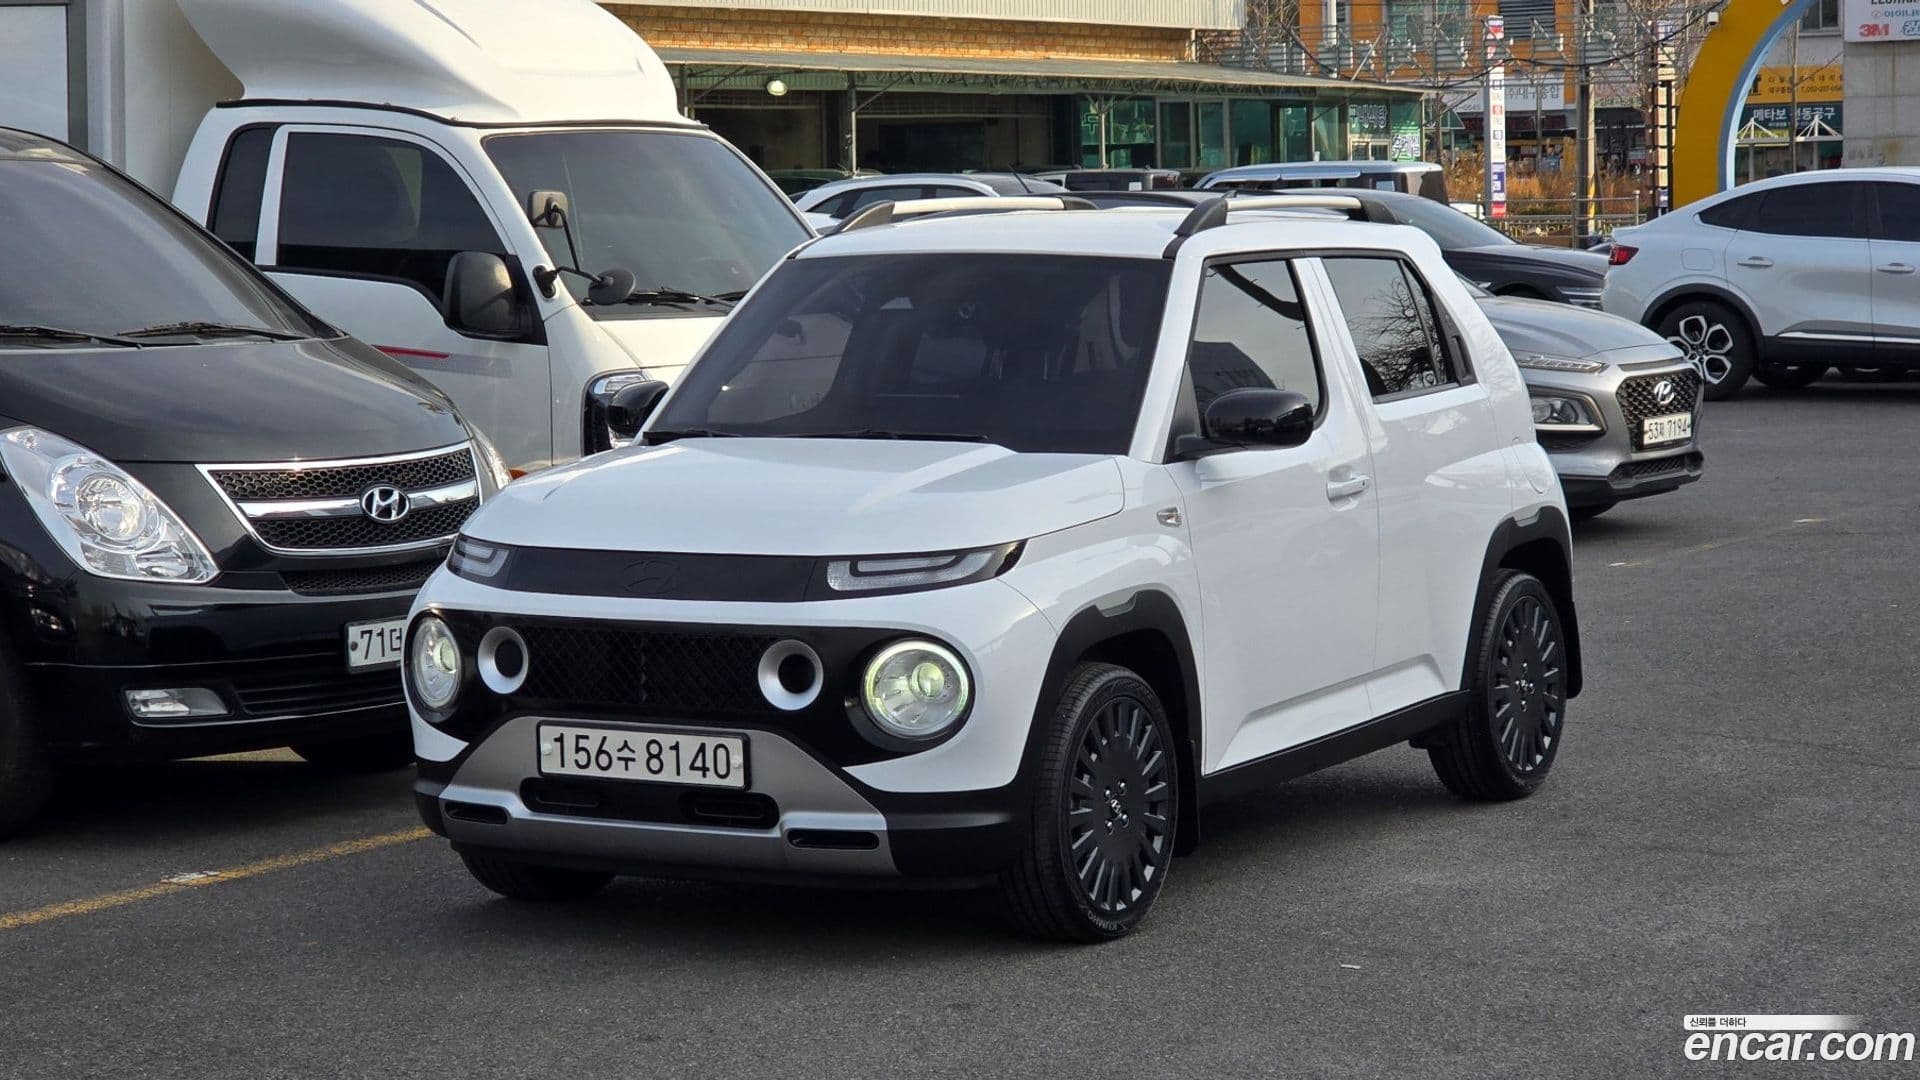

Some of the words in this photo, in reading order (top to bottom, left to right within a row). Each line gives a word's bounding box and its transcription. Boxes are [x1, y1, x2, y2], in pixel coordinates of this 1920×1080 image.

[1859, 23, 1890, 37] 3M
[1753, 107, 1788, 121] 메타보
[553, 732, 636, 772] 156수
[645, 738, 731, 780] 8140
